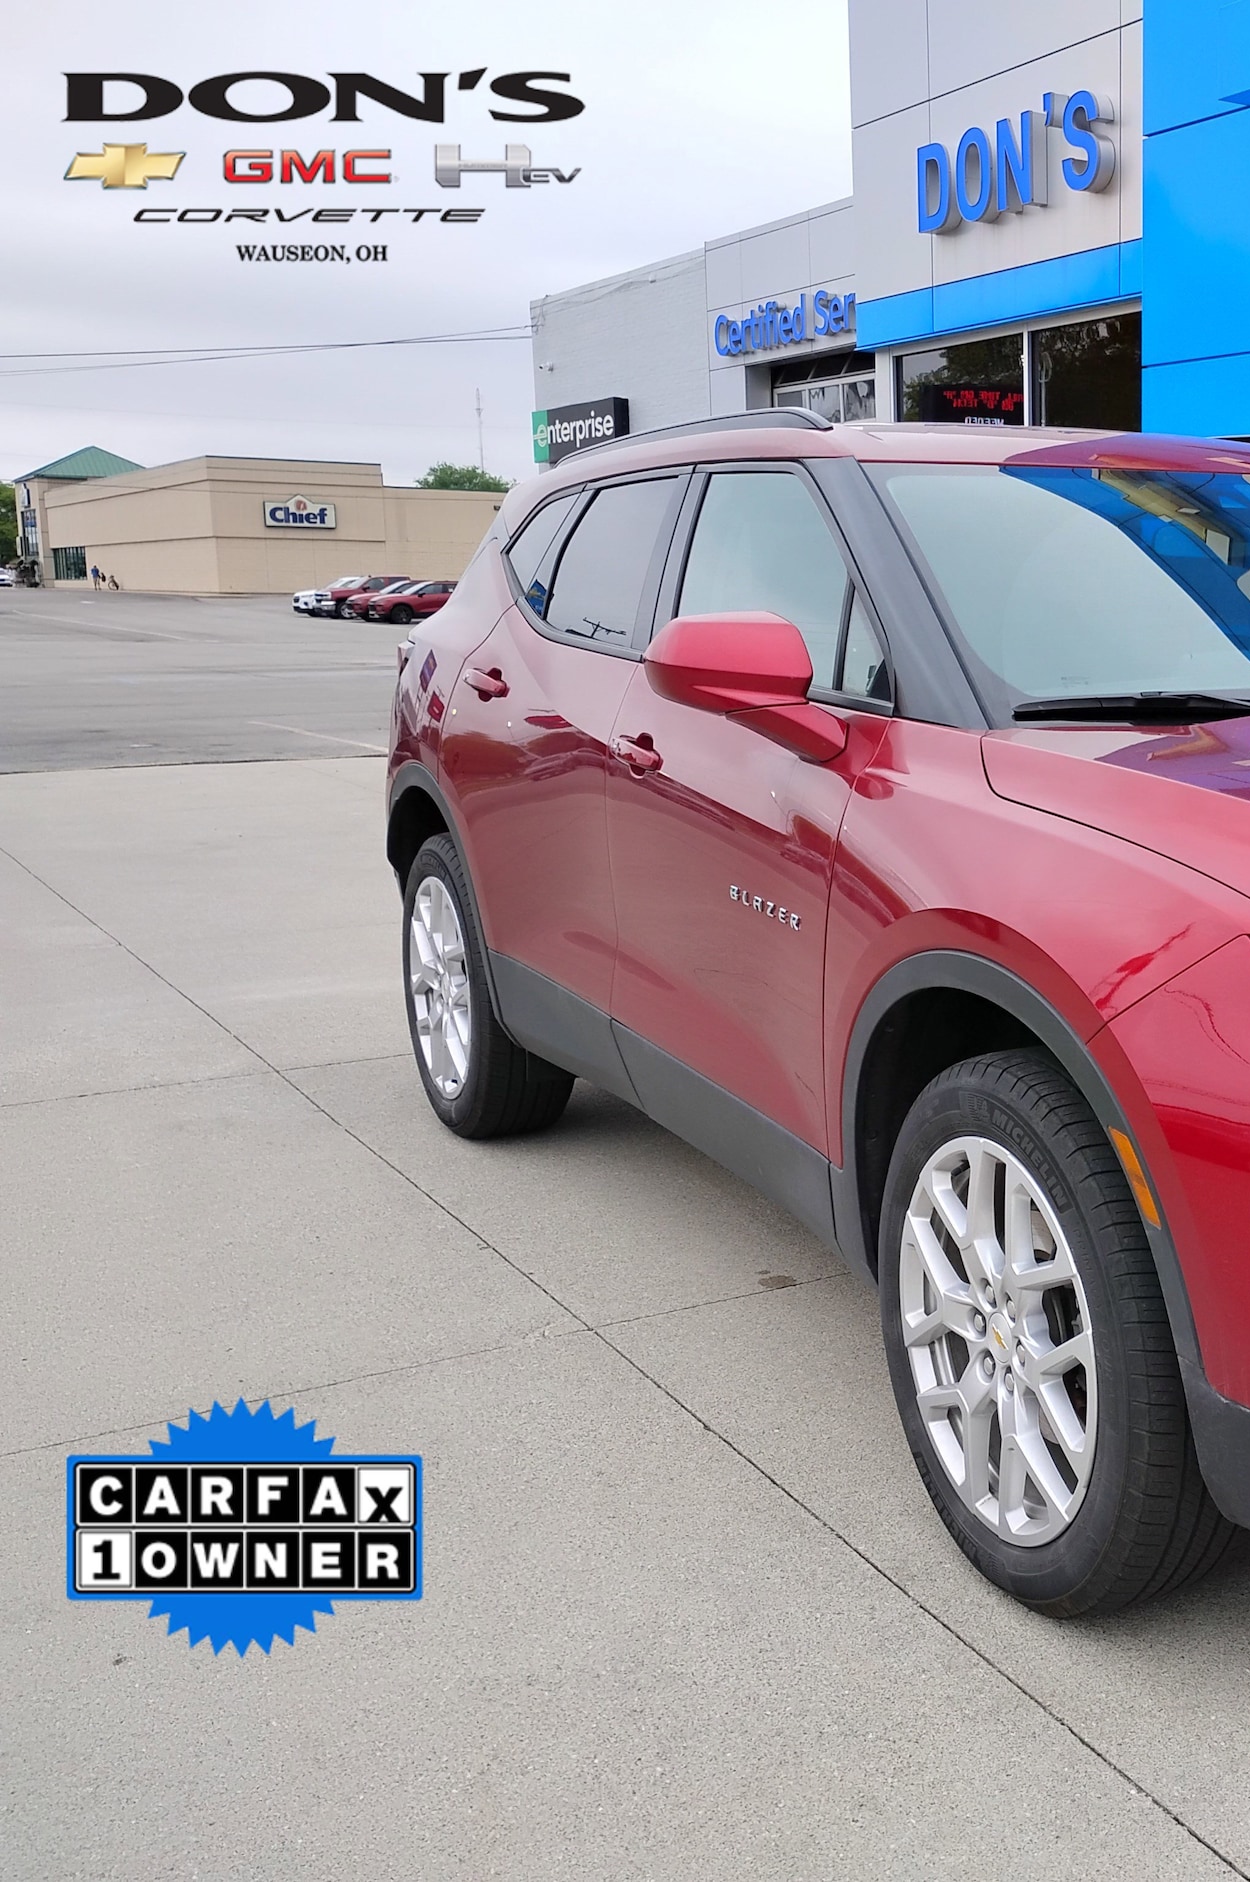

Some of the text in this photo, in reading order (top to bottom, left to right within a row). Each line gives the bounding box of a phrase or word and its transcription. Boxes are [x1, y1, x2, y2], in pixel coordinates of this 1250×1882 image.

[917, 89, 1116, 234] DON'S
[714, 293, 815, 357] Certified
[533, 409, 614, 448] enterprise
[269, 506, 328, 525] Chief
[729, 884, 802, 932] BLAZER
[991, 1109, 1069, 1209] MICHELIN
